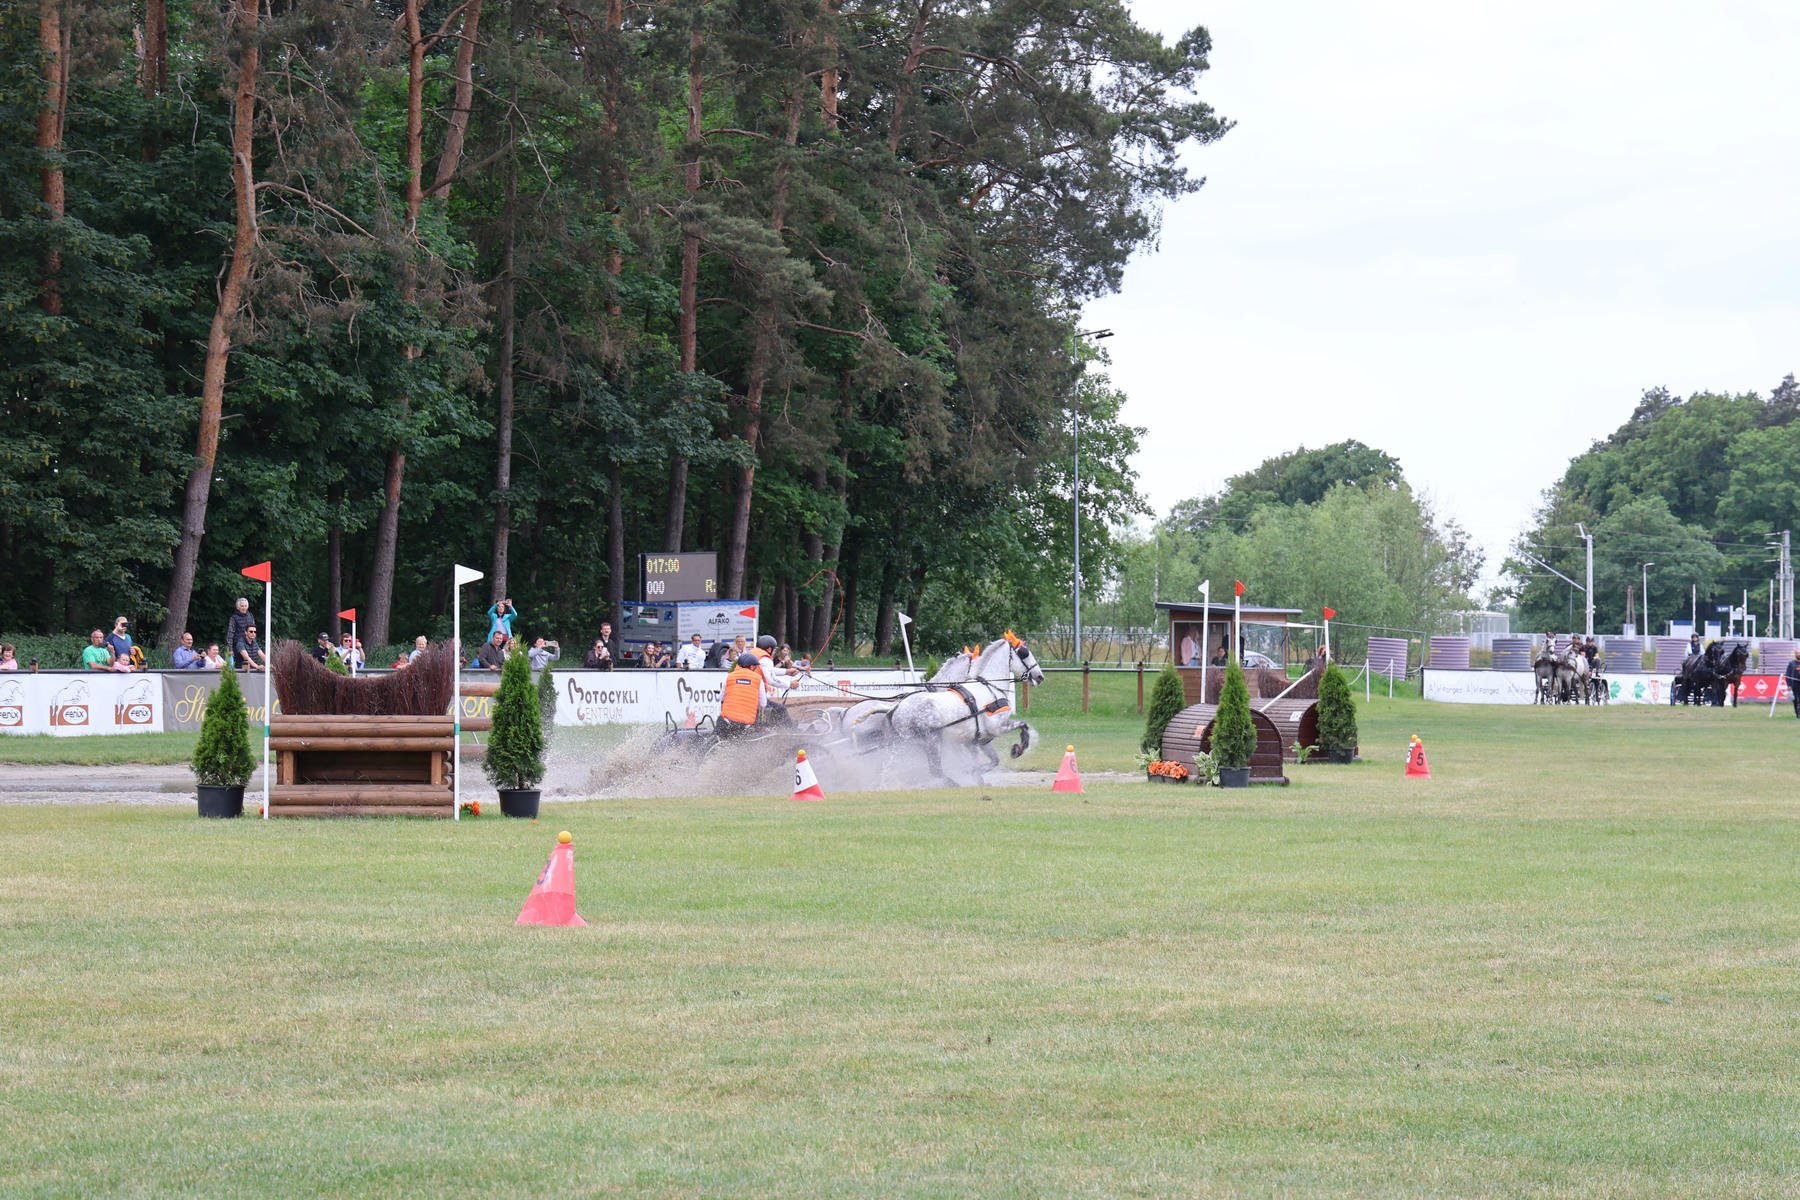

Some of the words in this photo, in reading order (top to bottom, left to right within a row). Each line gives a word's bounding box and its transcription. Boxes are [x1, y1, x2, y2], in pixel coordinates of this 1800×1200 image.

[646, 558, 680, 573] 017:00
[646, 581, 665, 594] 000
[707, 617, 730, 625] ALFAKO
[1416, 752, 1424, 767] 5
